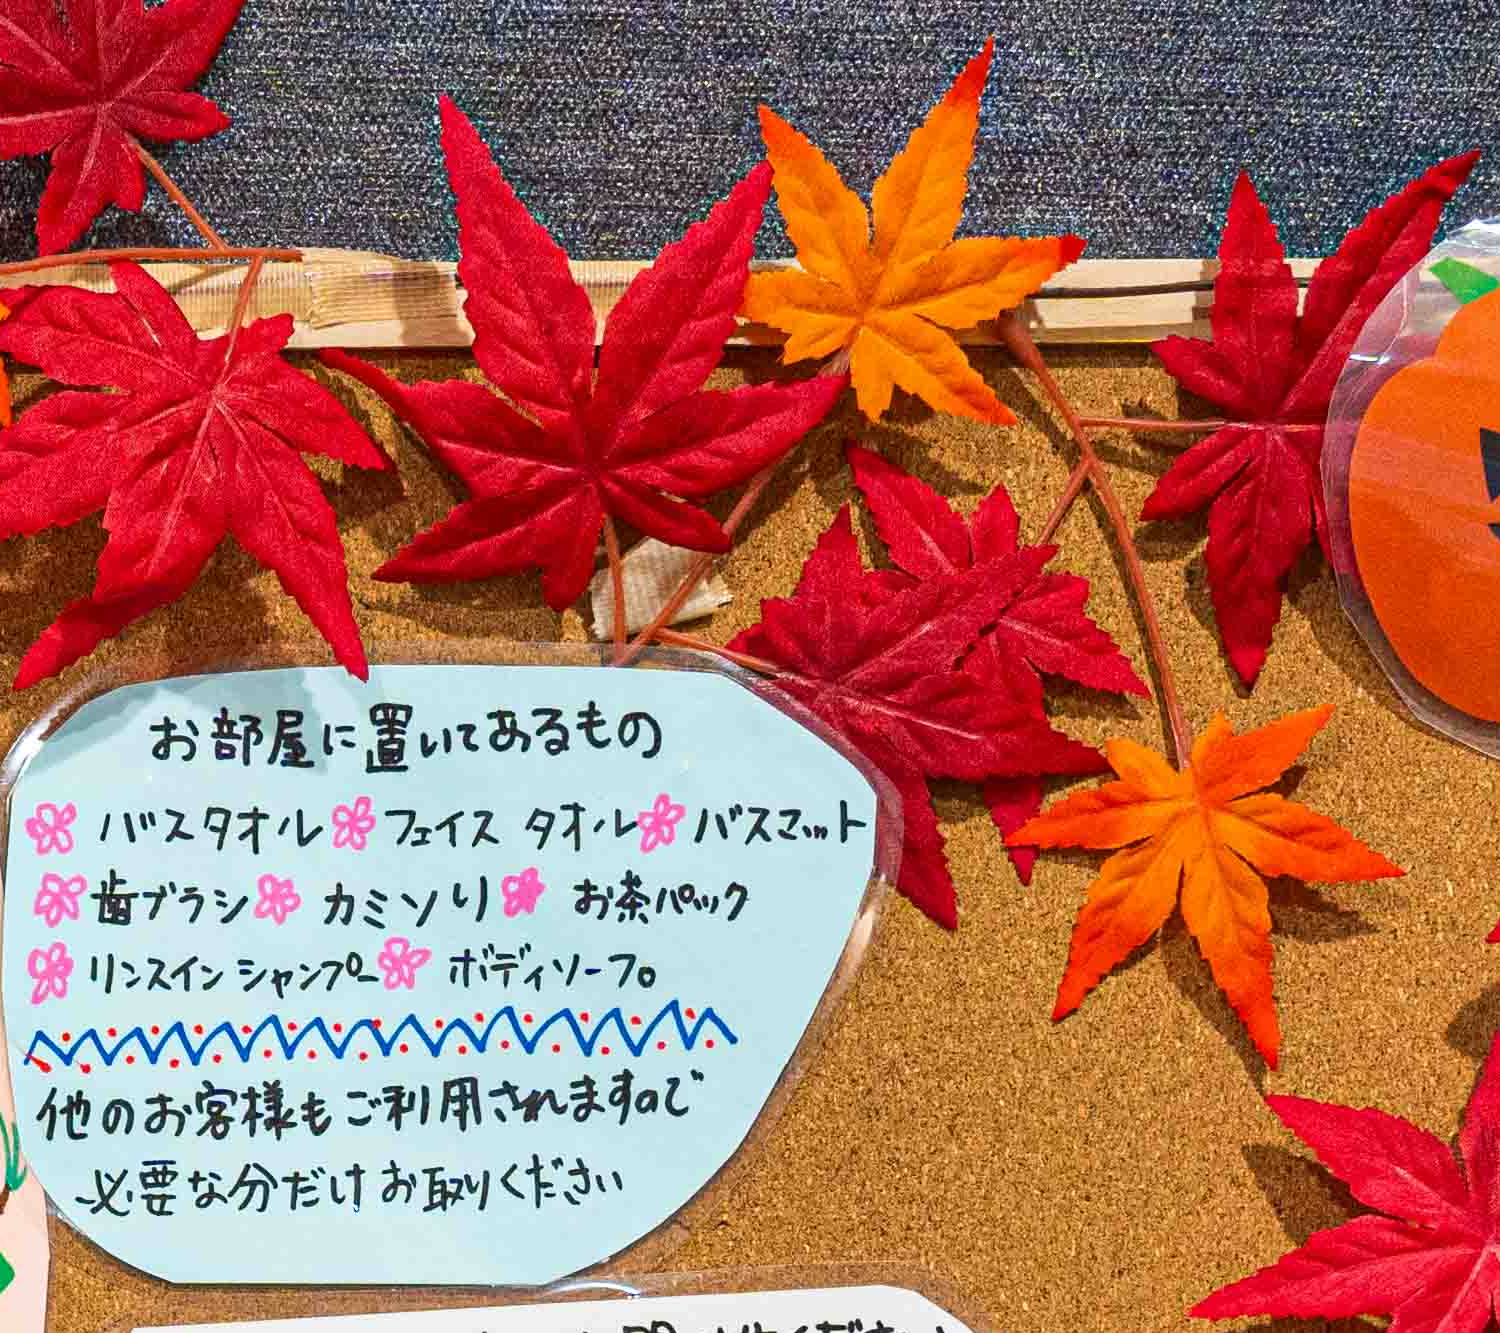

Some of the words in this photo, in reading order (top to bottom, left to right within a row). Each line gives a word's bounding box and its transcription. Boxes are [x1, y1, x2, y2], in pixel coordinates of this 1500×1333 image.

[150, 702, 662, 774] お部屋に置いてあるもの
[100, 805, 322, 846] バスタオル
[695, 806, 867, 845] バスマット
[91, 869, 250, 926] 歯ブラシ
[325, 876, 488, 927] カミソリ
[575, 878, 750, 925] お茶パック
[449, 946, 656, 990] ボディソープ
[37, 1068, 702, 1141] 他のお客様もご利用されますので
[75, 1157, 622, 1218] 必要な分だけお取りください
